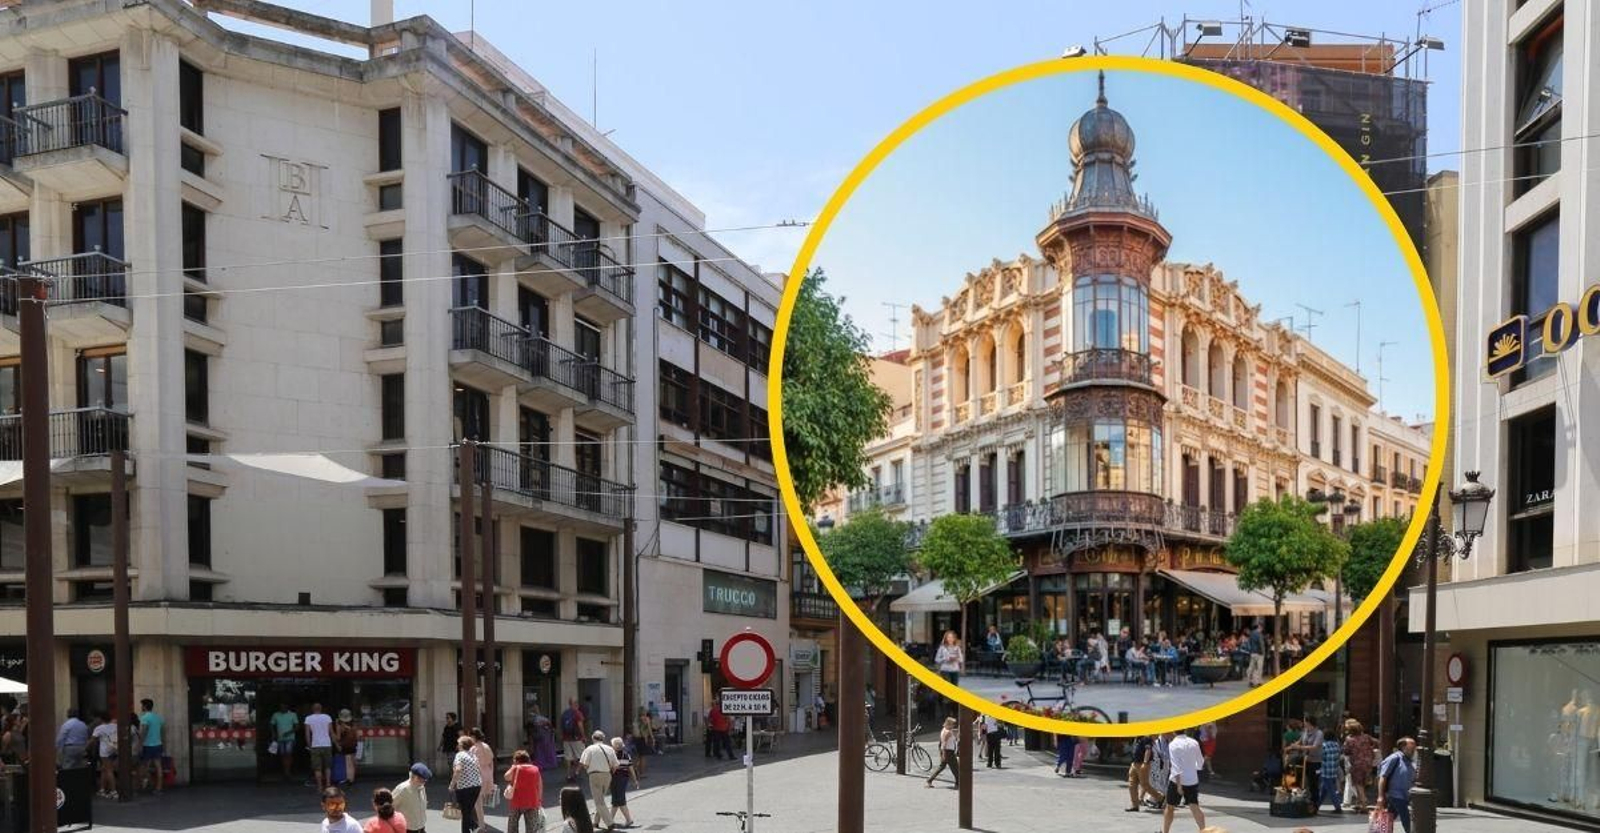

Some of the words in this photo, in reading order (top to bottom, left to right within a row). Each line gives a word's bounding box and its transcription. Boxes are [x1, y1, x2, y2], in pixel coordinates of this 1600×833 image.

[1360, 113, 1370, 145] GIN
[708, 585, 756, 606] TRUCCO
[208, 651, 322, 672] BURGER
[333, 652, 400, 672] KING
[723, 693, 748, 701] EXCEPTO
